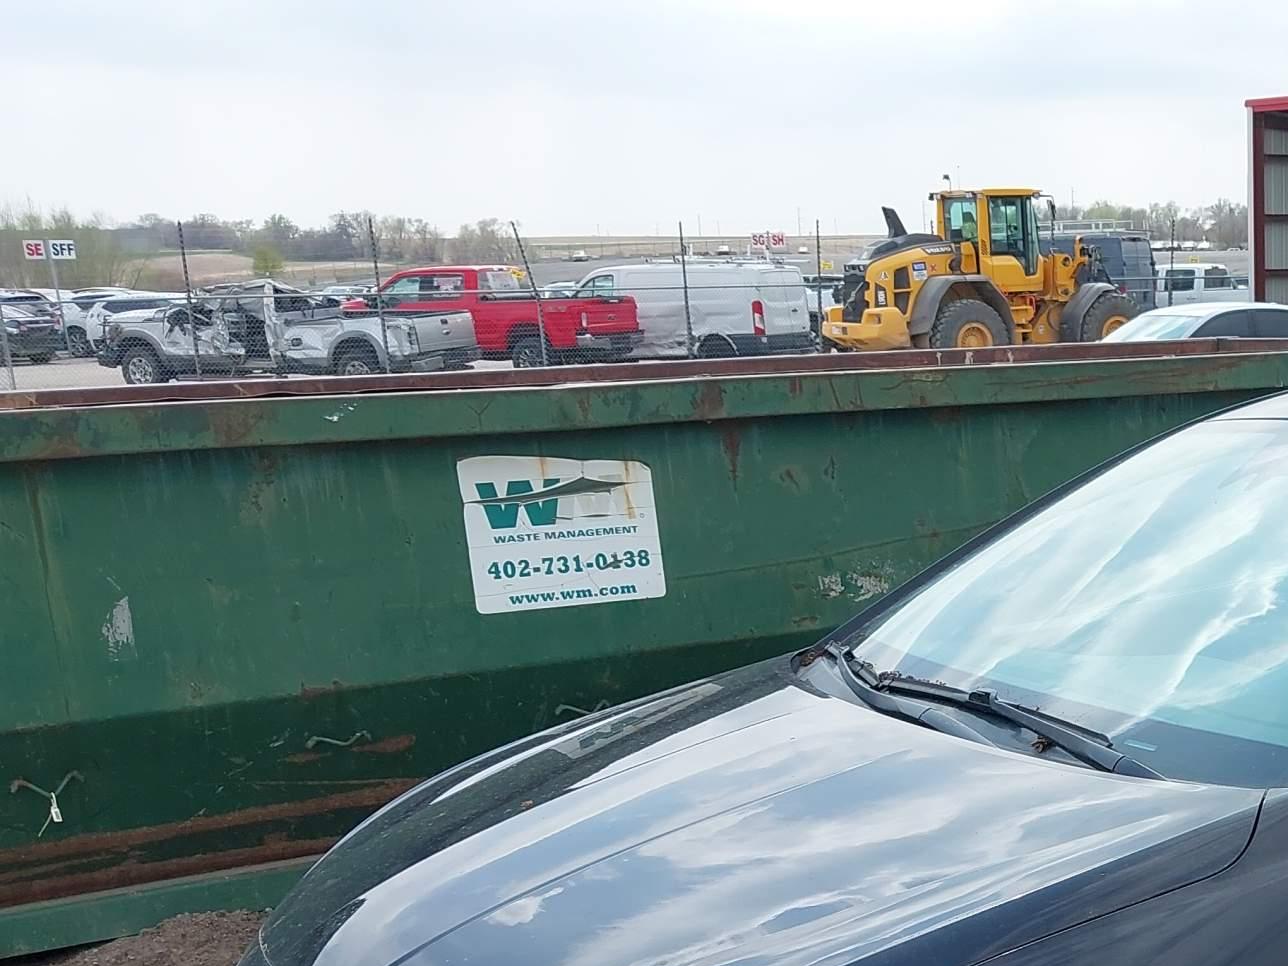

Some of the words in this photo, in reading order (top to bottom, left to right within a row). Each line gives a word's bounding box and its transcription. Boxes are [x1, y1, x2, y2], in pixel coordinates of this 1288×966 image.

[752, 234, 765, 246] SG
[771, 234, 785, 246] SH
[26, 243, 44, 256] SE
[51, 243, 75, 256] SFF
[493, 532, 541, 544] WASTE
[544, 525, 639, 540] MANAGEMENT
[487, 549, 651, 580] 402-731-0138
[509, 583, 638, 605] www.wm.com
